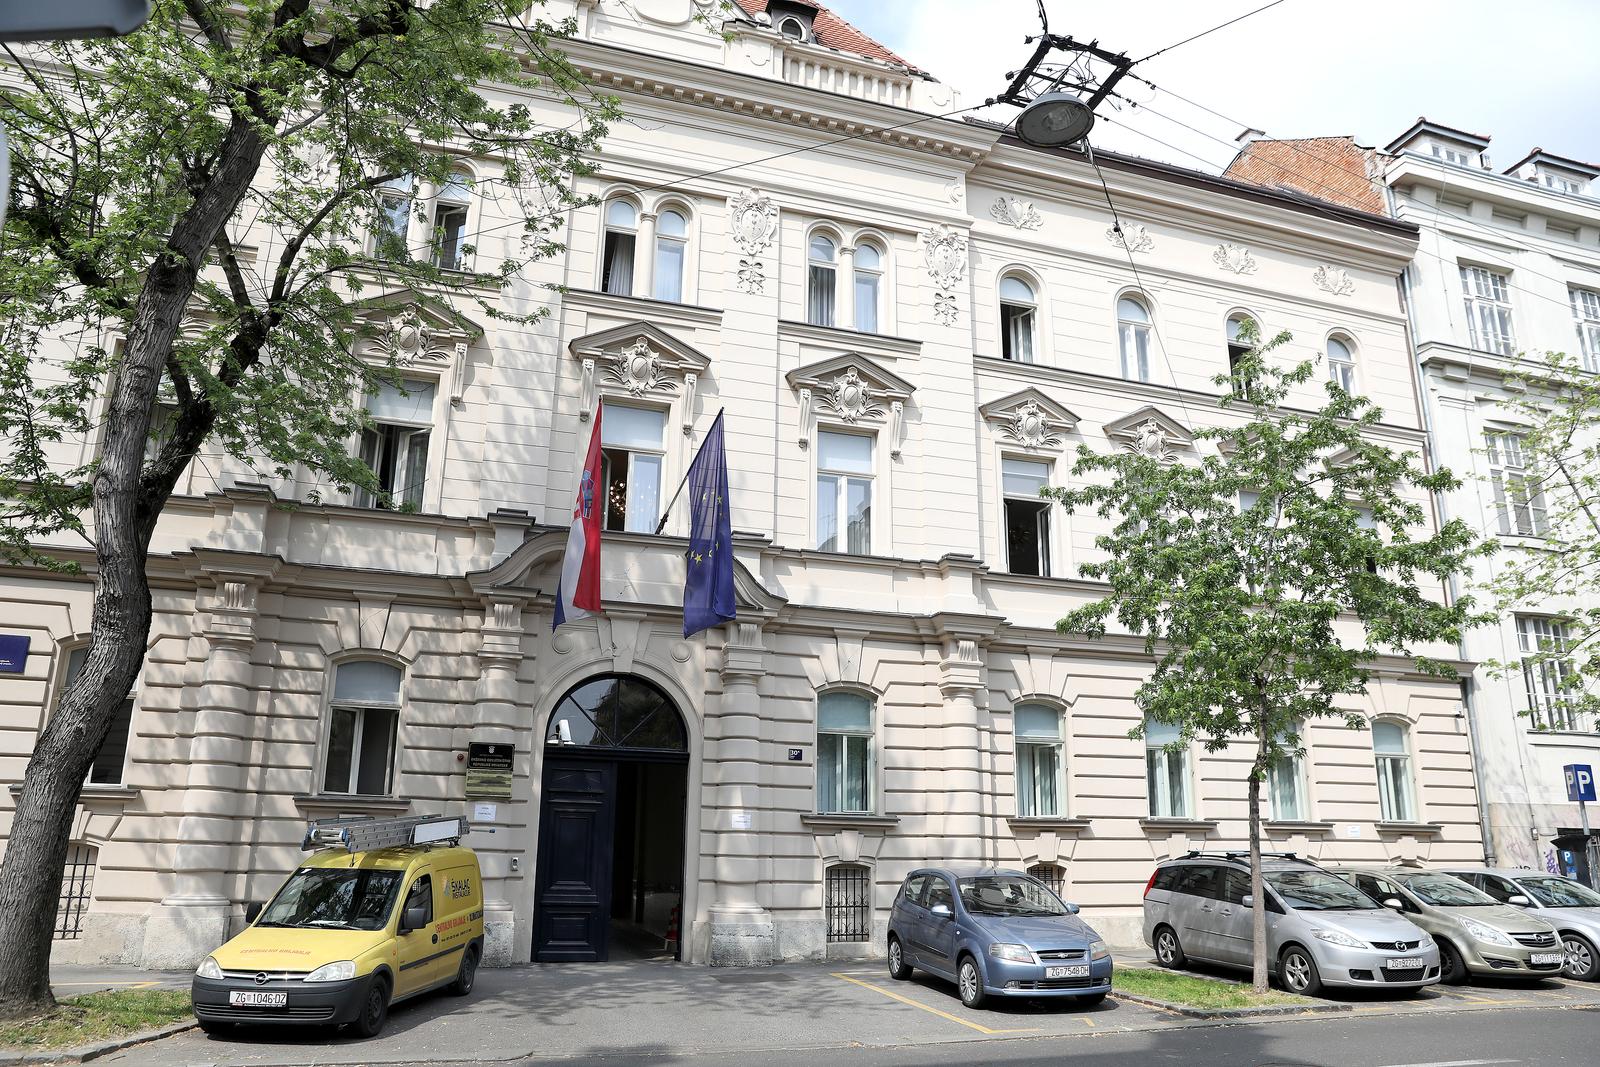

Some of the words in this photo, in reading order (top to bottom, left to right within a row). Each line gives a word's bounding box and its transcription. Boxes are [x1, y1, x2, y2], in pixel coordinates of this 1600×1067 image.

[1577, 770, 1591, 794] P
[1564, 851, 1571, 862] P
[1051, 967, 1060, 977] ZG
[235, 992, 246, 1003] ZG
